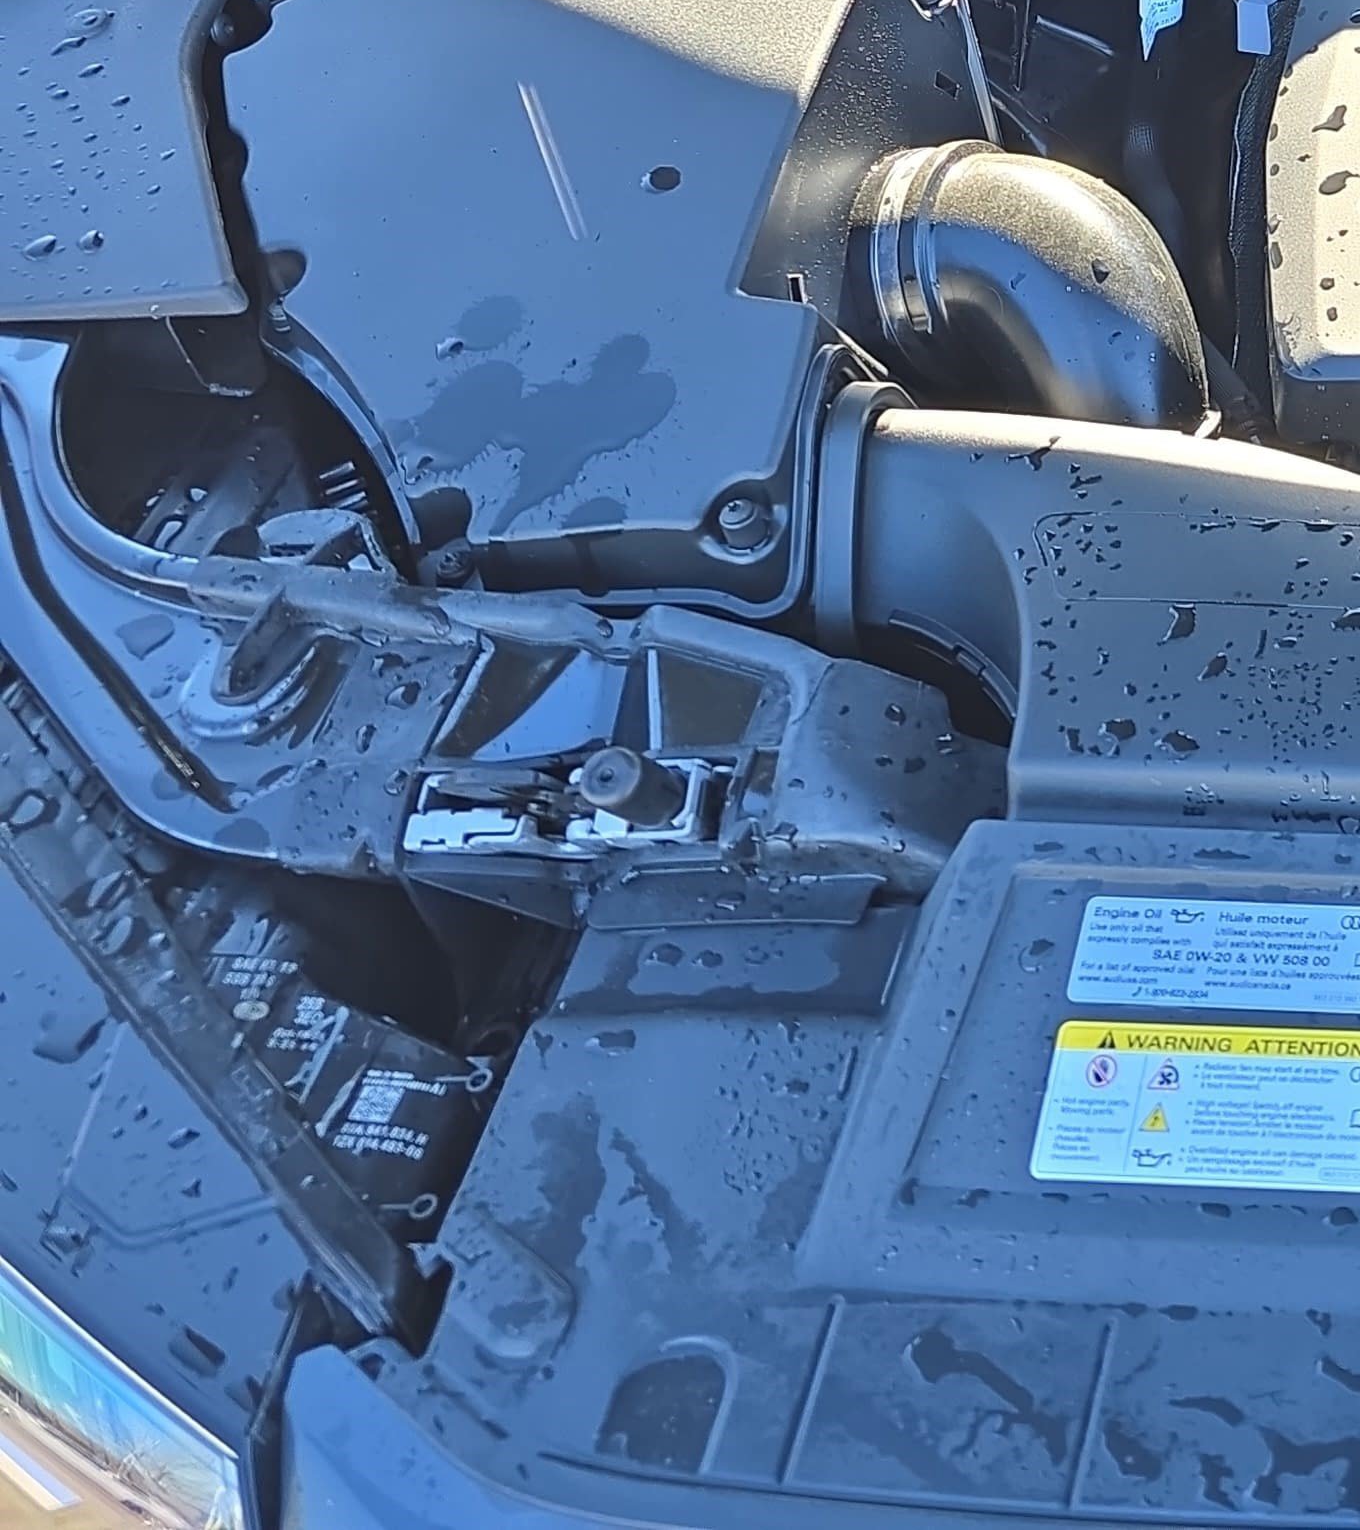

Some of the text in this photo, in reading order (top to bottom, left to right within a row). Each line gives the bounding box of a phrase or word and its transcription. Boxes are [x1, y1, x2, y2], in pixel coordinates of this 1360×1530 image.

[1094, 906, 1163, 920] Engine Oil
[1218, 911, 1309, 925] Huile moteur
[1151, 949, 1331, 967] SAE 0W-20 & VW 508 00
[1126, 1034, 1233, 1053] WARNING
